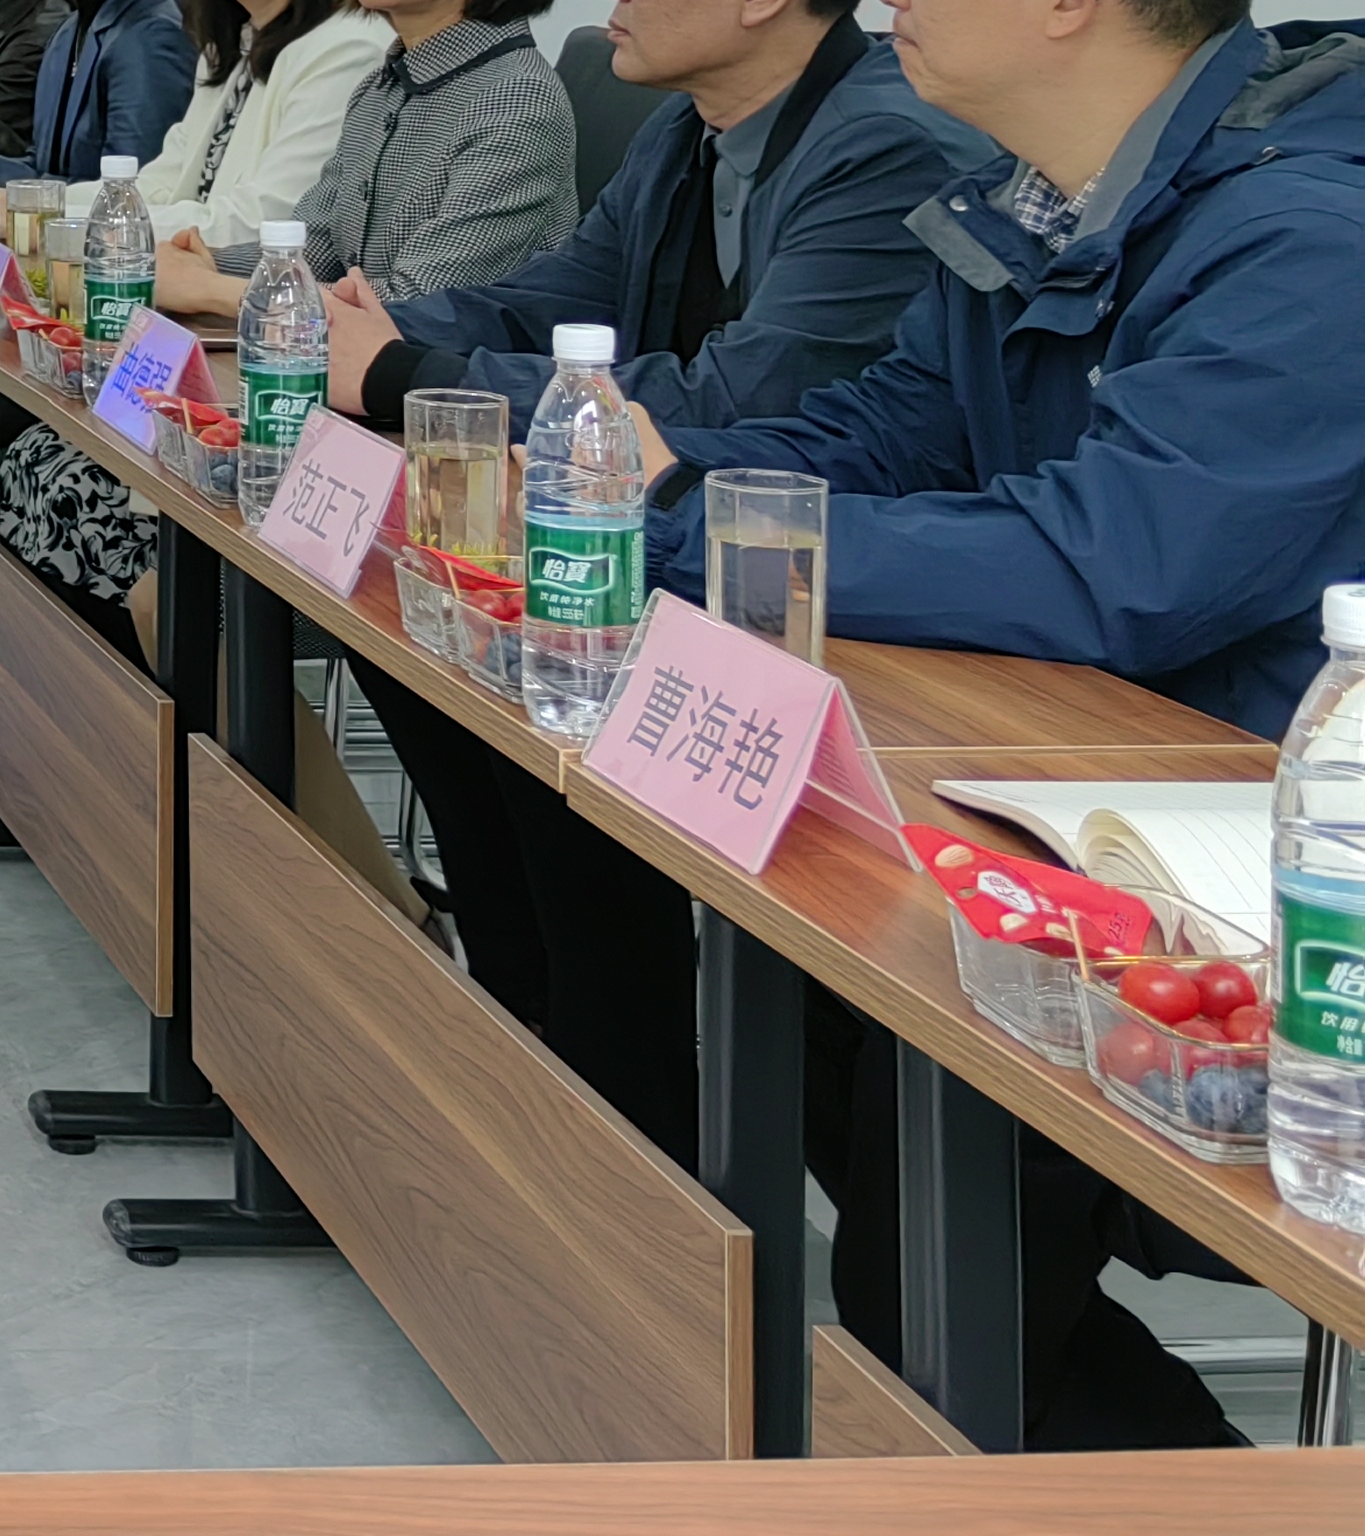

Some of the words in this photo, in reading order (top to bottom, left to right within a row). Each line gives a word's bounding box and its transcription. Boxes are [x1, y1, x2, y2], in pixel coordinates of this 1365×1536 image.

[282, 458, 370, 558] 范正飞
[626, 665, 784, 811] 曹海艳
